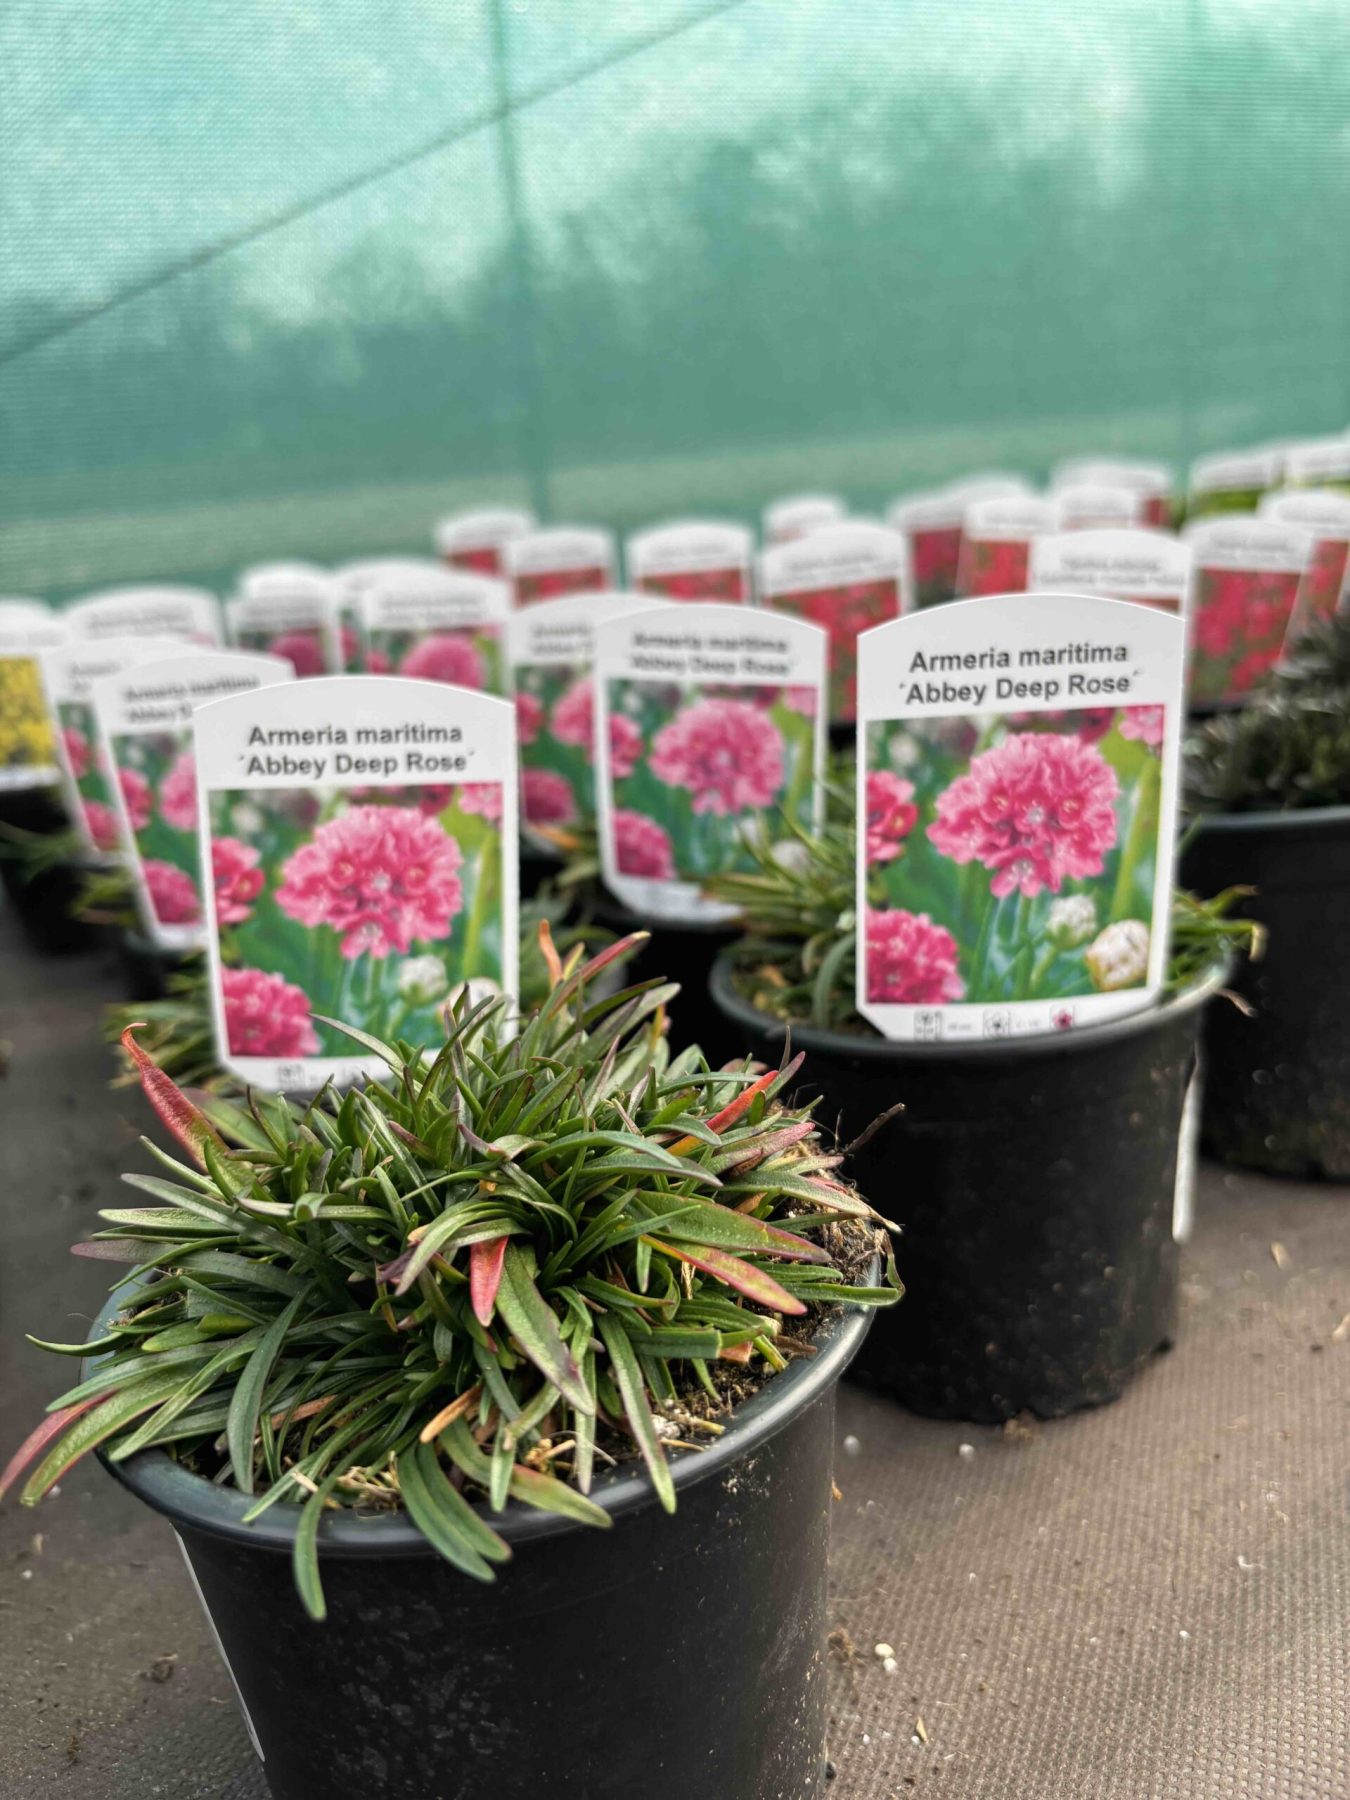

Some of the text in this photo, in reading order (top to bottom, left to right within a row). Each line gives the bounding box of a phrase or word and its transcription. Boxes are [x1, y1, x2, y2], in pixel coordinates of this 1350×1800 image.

[909, 643, 1128, 673] Armeria maritima
[996, 677, 1060, 700] Deep
[249, 724, 462, 746] Armeria maritima
[335, 752, 398, 776] Deep
